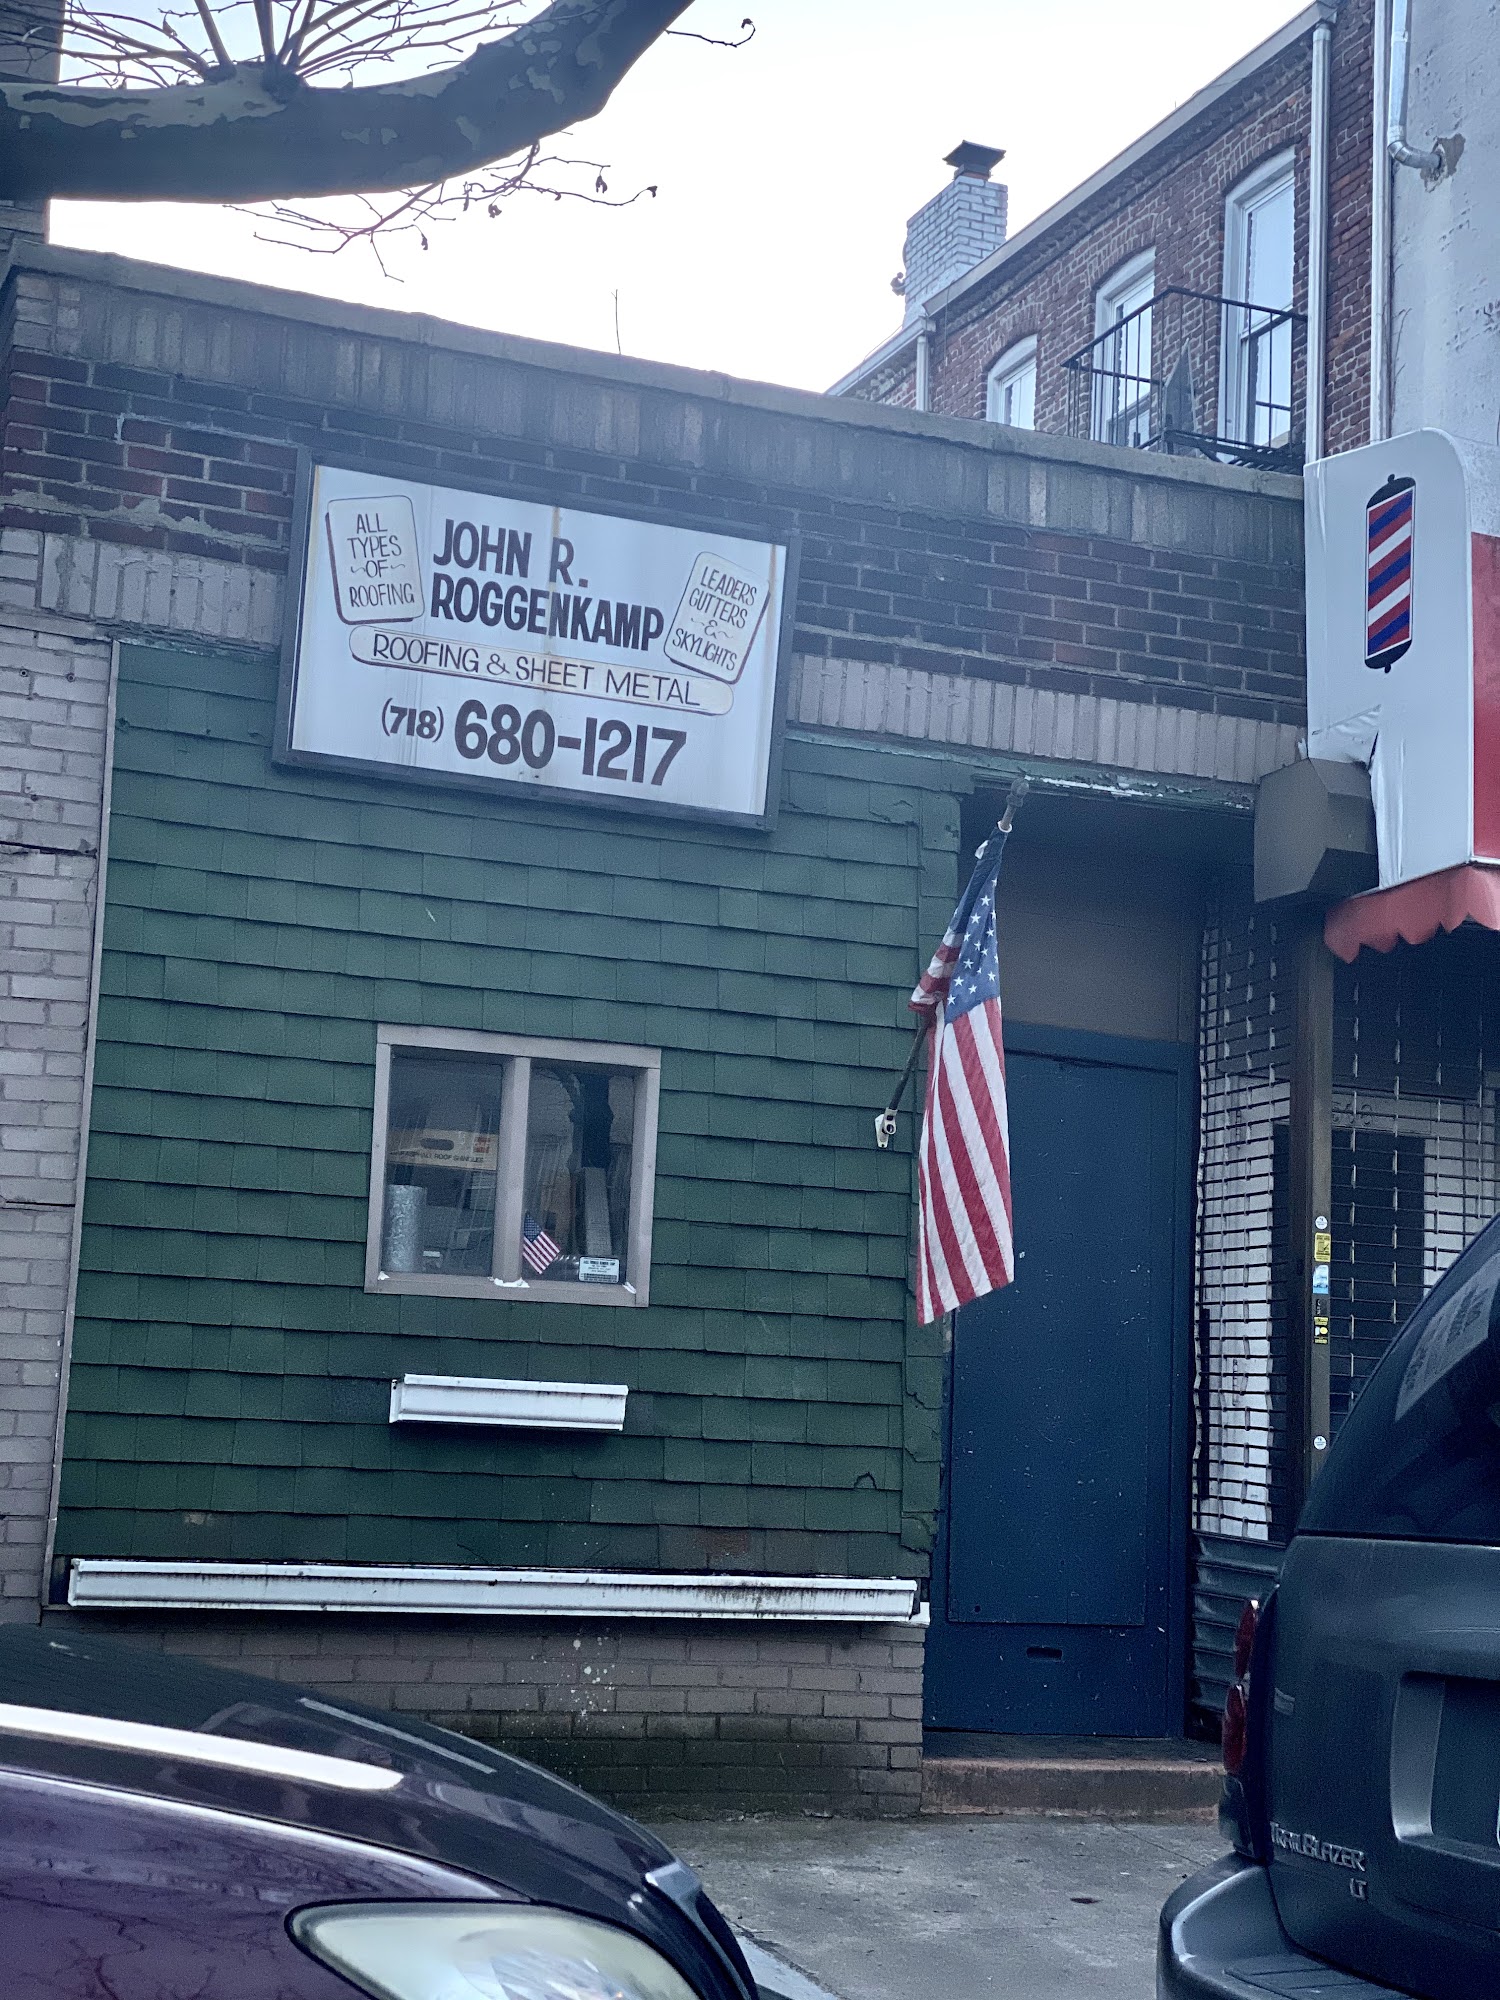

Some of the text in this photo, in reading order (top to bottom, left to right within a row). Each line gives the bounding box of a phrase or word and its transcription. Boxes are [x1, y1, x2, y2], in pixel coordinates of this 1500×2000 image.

[356, 512, 388, 534] ALL
[346, 534, 402, 560] TYPES
[432, 518, 589, 588] JOHN R.
[365, 558, 389, 578] OF
[699, 565, 757, 606] LEADERS
[348, 582, 415, 608] ROOFING
[430, 571, 665, 652] ROGGENKAMP
[688, 587, 748, 629] GUTTERS
[672, 627, 738, 671] SKYLIGHTS
[703, 619, 718, 639] &
[372, 633, 701, 706] ROOFING & SHEET METAL
[381, 697, 688, 786] (718) 680-1217
